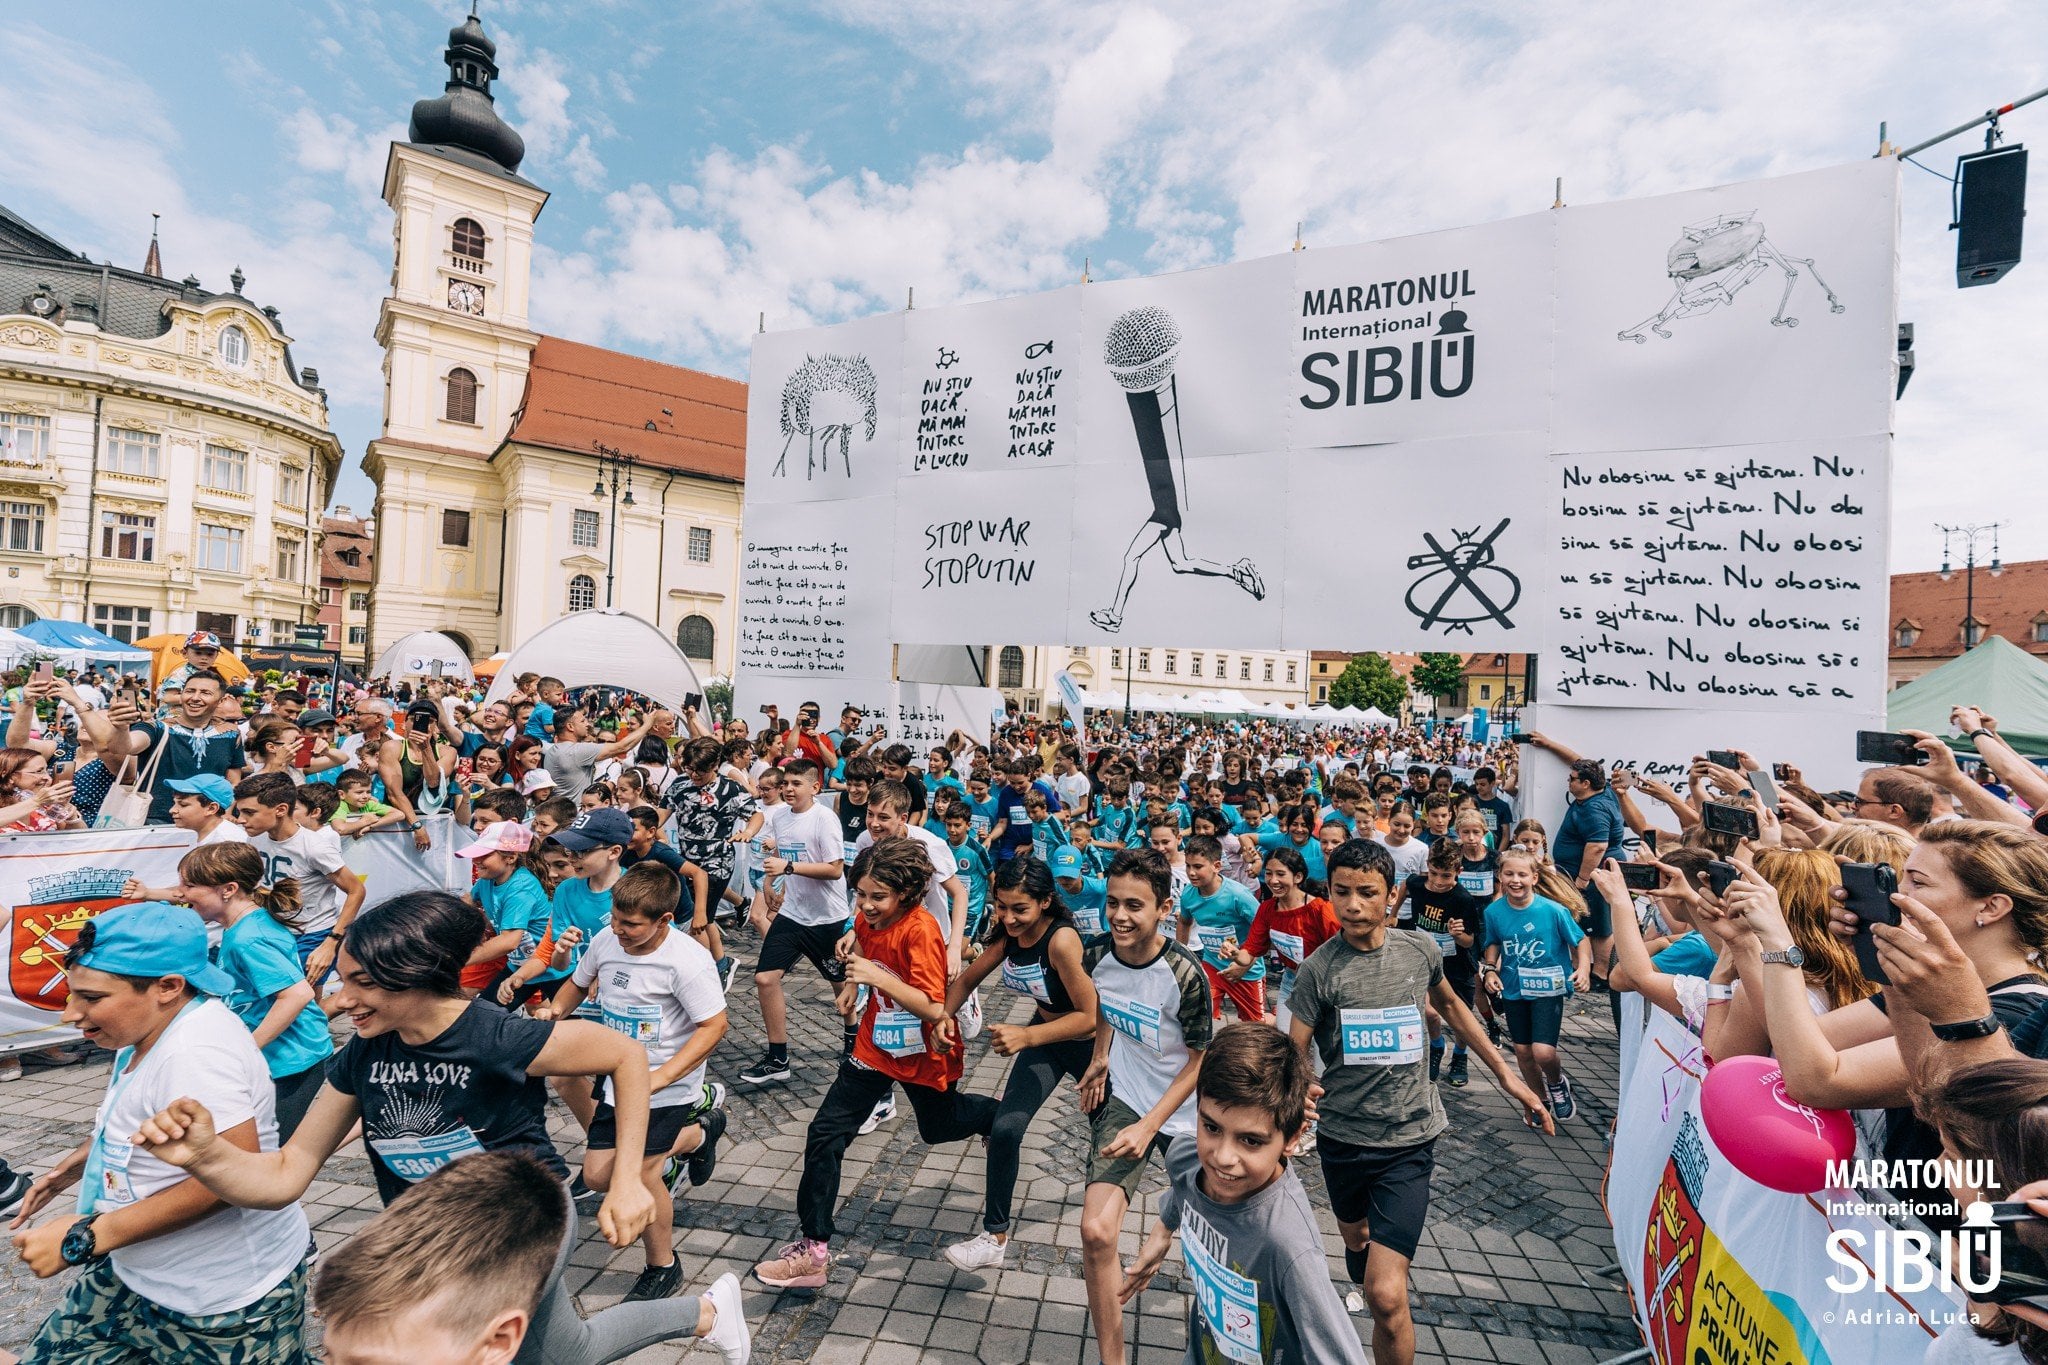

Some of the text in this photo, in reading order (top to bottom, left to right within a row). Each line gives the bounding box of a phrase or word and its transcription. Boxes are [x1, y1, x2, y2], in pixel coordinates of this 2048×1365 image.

[1302, 269, 1476, 317] MARATONUL
[1303, 311, 1432, 340] Internațional
[1016, 366, 1063, 389] NU ȘTIU
[1299, 335, 1475, 410] SIBIU
[923, 377, 973, 397] NU ȘTIU
[1017, 384, 1055, 404] DACĂ
[921, 391, 964, 416] DACĂ
[1008, 404, 1056, 422] MĂ MAI
[918, 415, 966, 434] MĂ MAI
[1009, 421, 1056, 440] ÎNTORC
[916, 434, 965, 452] ÎNTORC
[1007, 439, 1055, 458] ACASĂ
[914, 452, 969, 471] LA LUCRU
[1563, 466, 1592, 489] Nu
[1812, 455, 1854, 477] Nu
[1773, 490, 1816, 515] Nu
[925, 517, 1031, 551] STOP WAR
[1740, 529, 1781, 553] Nu
[922, 553, 1035, 589] STOPUTIN
[1723, 564, 1762, 589] Nu
[1696, 603, 1736, 628] Nu
[1668, 637, 1710, 663] Nu
[1646, 670, 1686, 693] Nu
[1424, 904, 1444, 921] THE
[1523, 978, 1550, 989] 5896
[875, 1029, 900, 1045] 5984
[1349, 1029, 1394, 1049] 5863
[368, 1060, 472, 1090] LUNA LOVE
